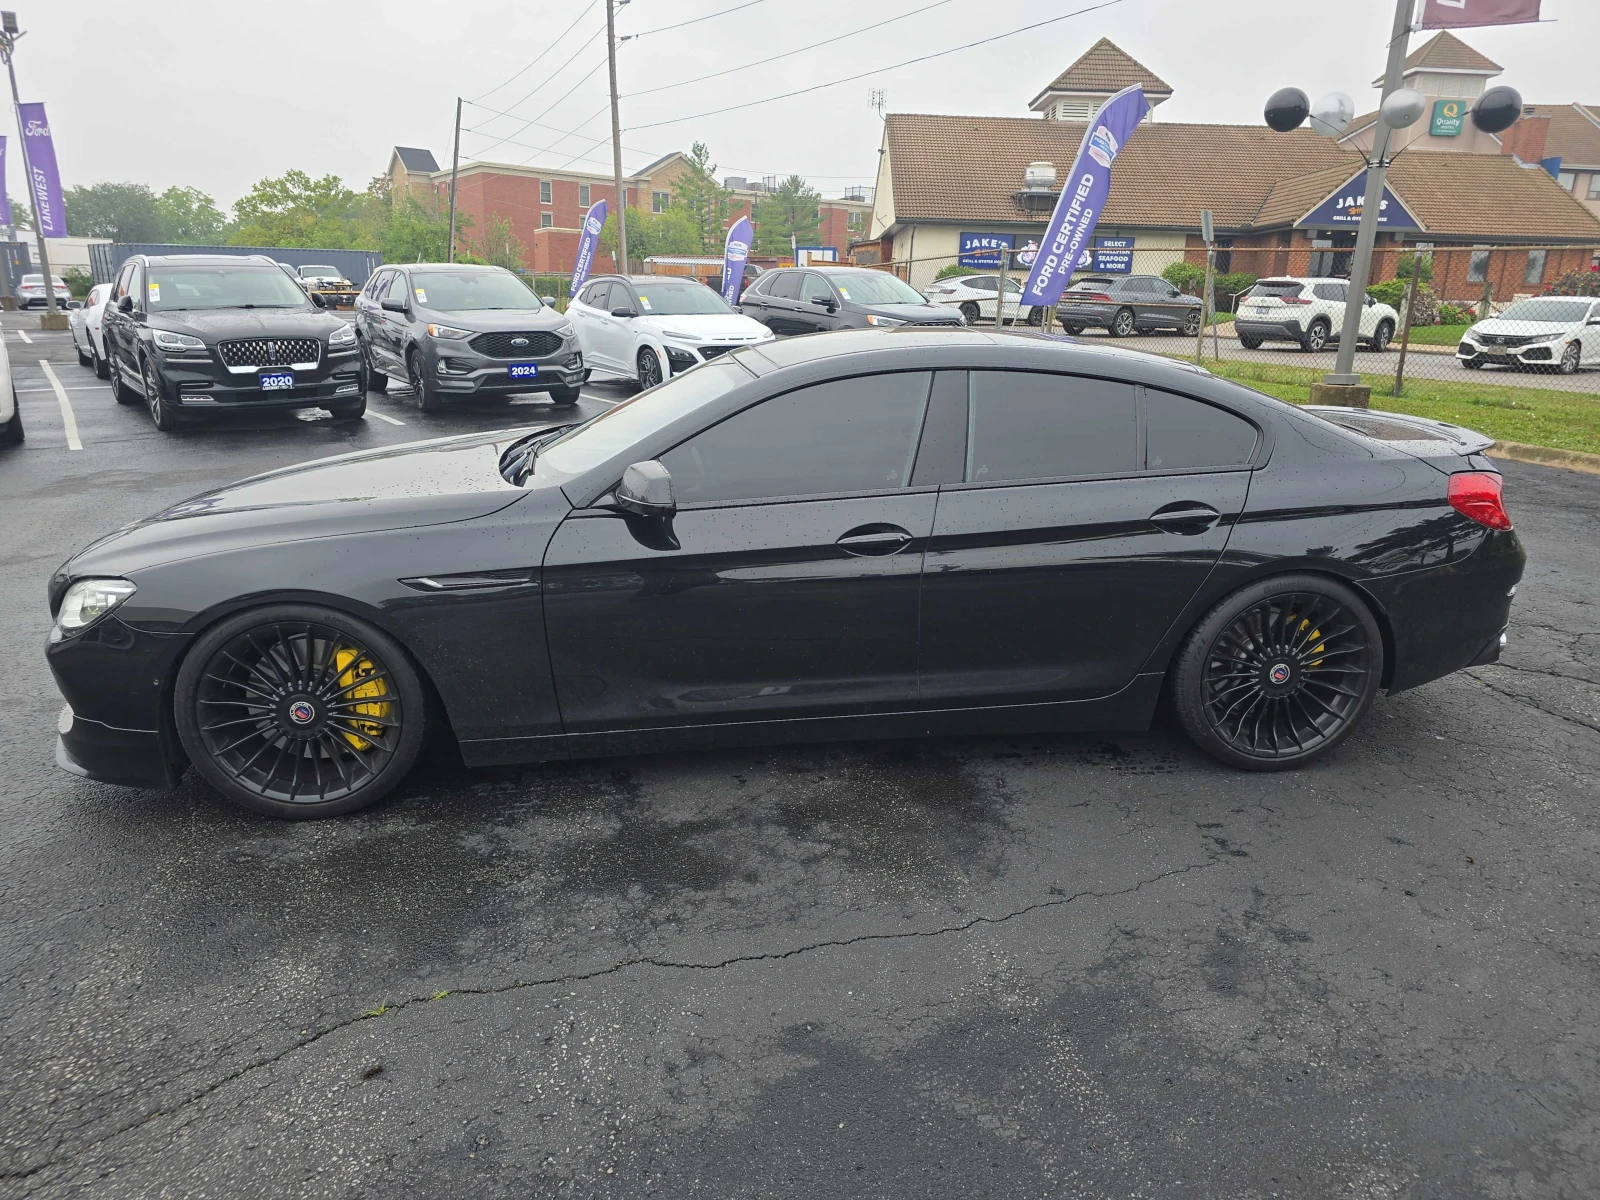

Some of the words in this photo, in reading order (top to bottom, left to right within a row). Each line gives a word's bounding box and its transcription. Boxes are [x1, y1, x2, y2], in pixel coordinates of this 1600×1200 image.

[26, 120, 51, 137] Ford
[1436, 117, 1460, 127] Quality
[33, 166, 54, 231] LAKEWEST
[1336, 195, 1389, 210] JAKS
[1031, 254, 1058, 296] FORD
[1052, 173, 1094, 254] CERTIFIED
[1057, 208, 1093, 275] PRE-OWNED
[965, 238, 1007, 249] JAKE'
[571, 272, 580, 291] FORD
[577, 237, 591, 272] CERTIFIED
[512, 366, 536, 375] 2024
[262, 376, 292, 386] 2020
